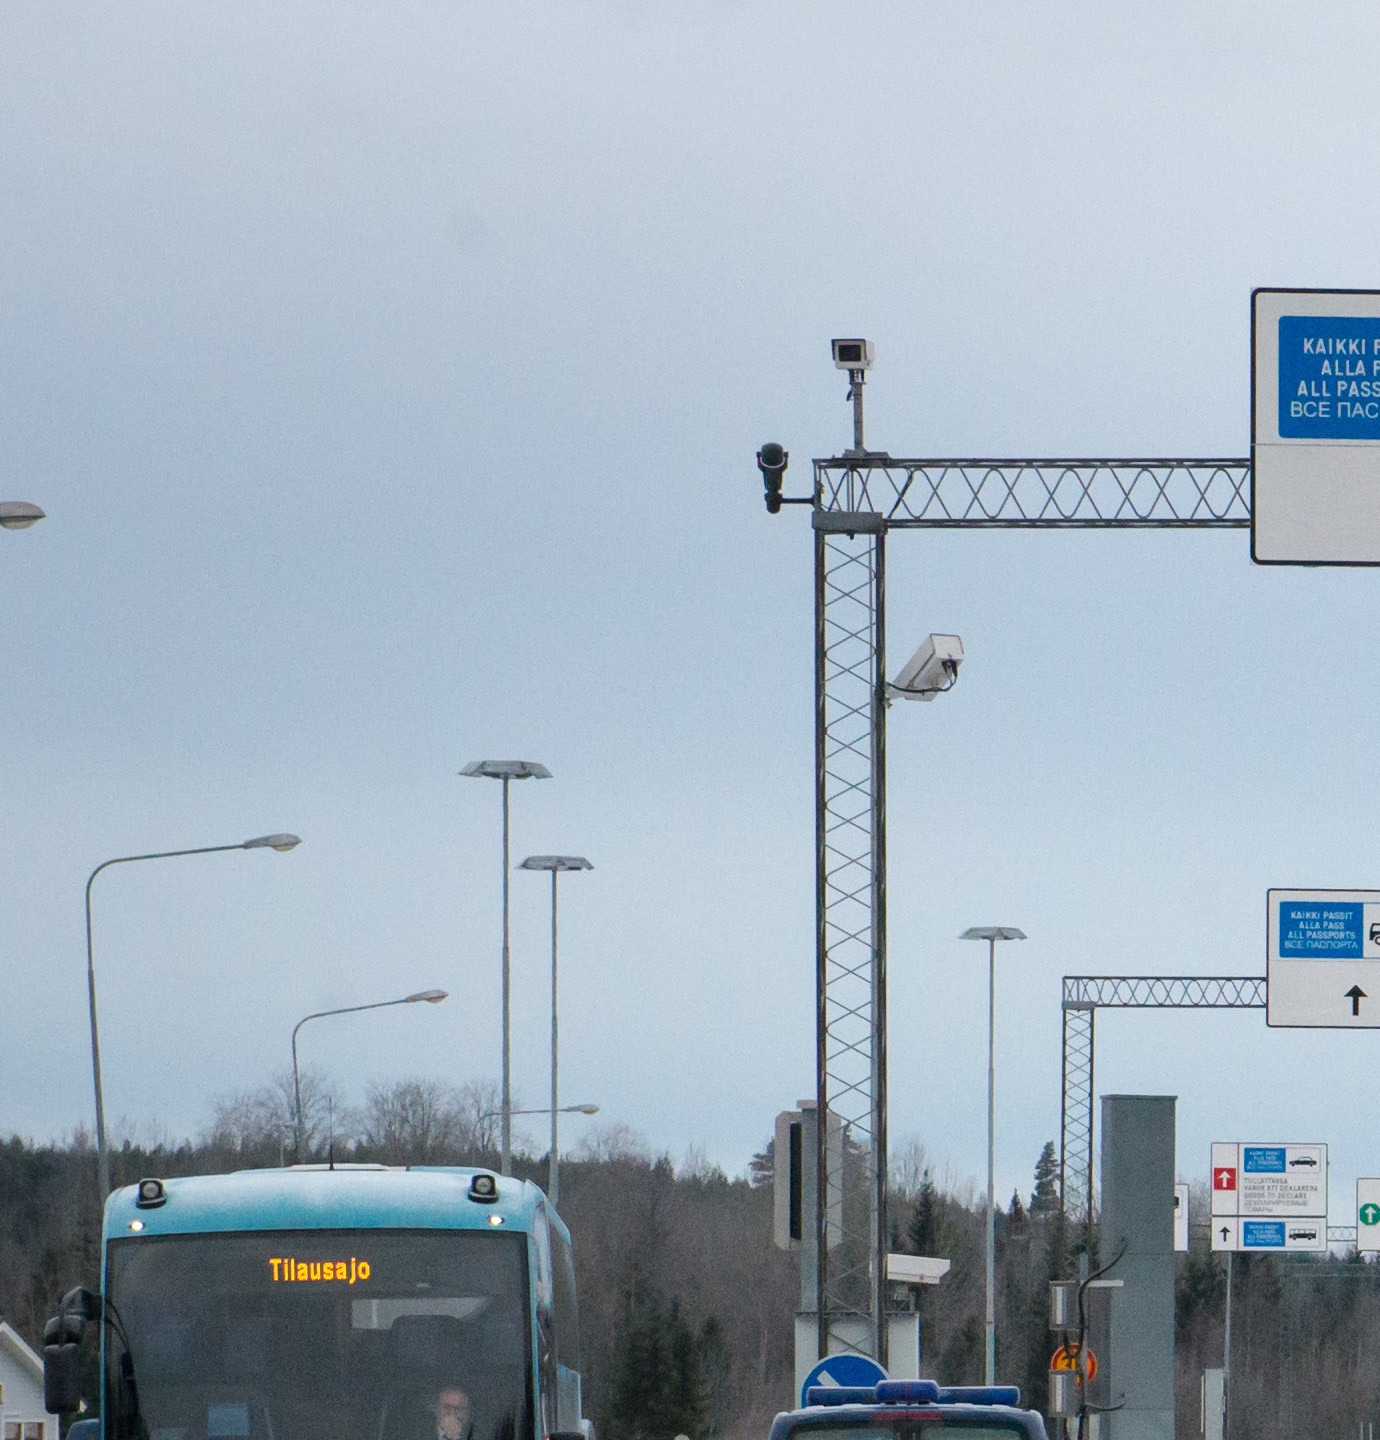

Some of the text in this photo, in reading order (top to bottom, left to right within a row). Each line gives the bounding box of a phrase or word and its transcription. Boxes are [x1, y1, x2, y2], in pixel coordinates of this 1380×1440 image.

[1302, 338, 1366, 355] KAIKKI
[1321, 359, 1366, 376] ALLA
[1297, 380, 1331, 397] ALL
[1290, 401, 1331, 418] ВСЕ
[1290, 910, 1353, 920] KAIKKI PASSIT
[1298, 921, 1345, 930] ALLA PASS
[1287, 930, 1356, 940] ALL PASSPORTS
[269, 1256, 371, 1285] Tilausajo
